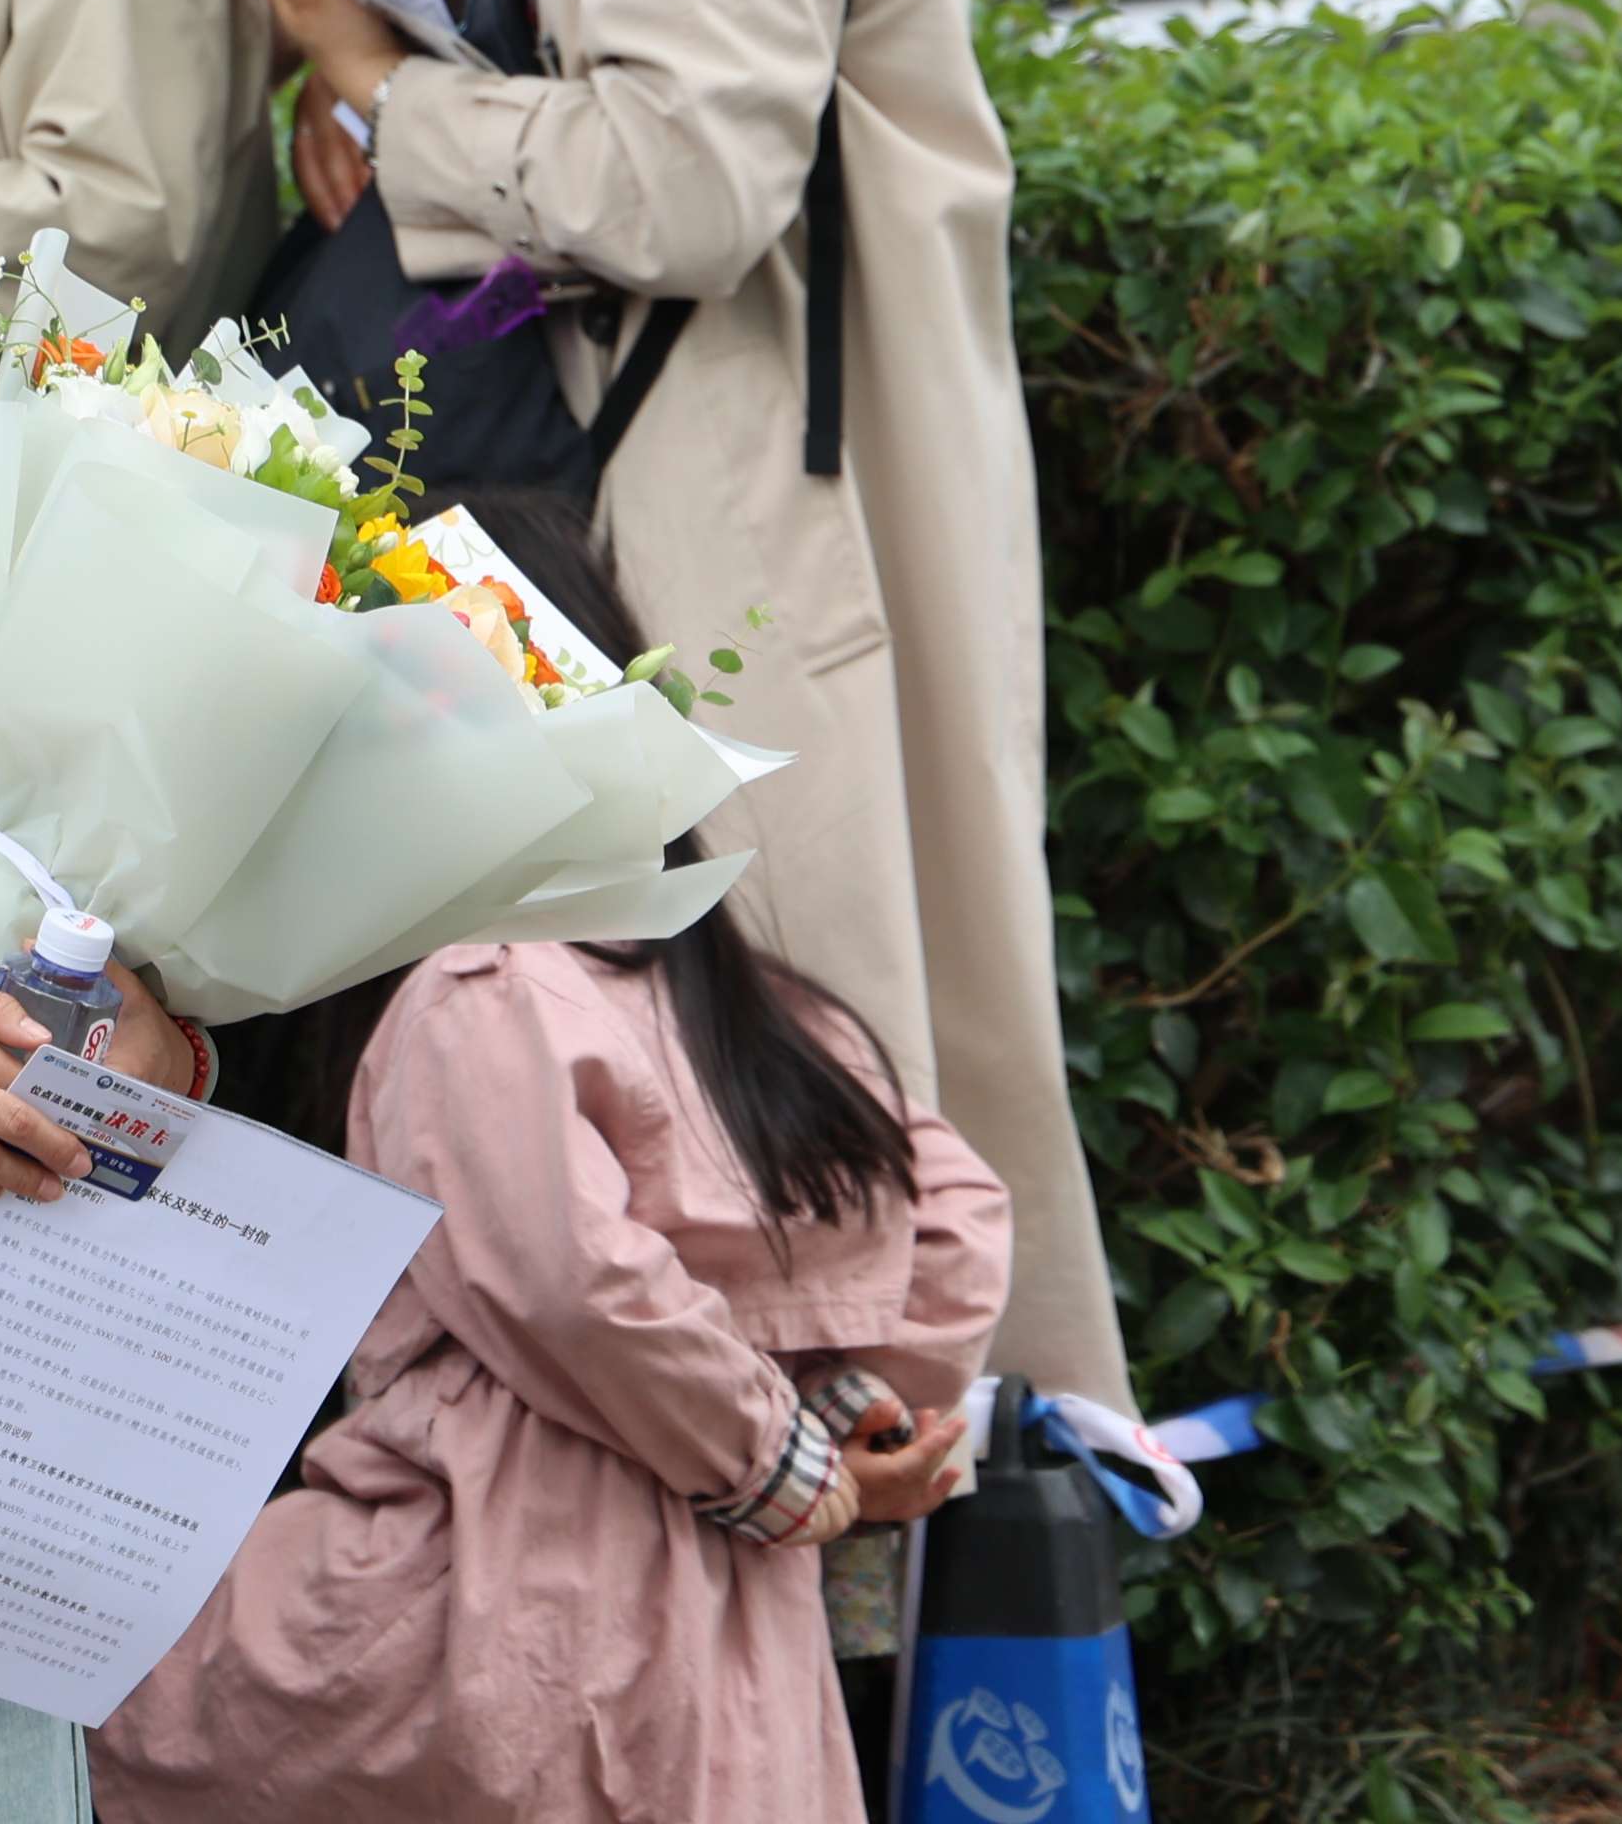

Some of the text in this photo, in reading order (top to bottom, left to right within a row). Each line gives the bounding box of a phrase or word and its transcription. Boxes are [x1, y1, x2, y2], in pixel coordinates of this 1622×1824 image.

[105, 1109, 170, 1148] 决策卡
[144, 1184, 272, 1248] 家长及学生的一封信
